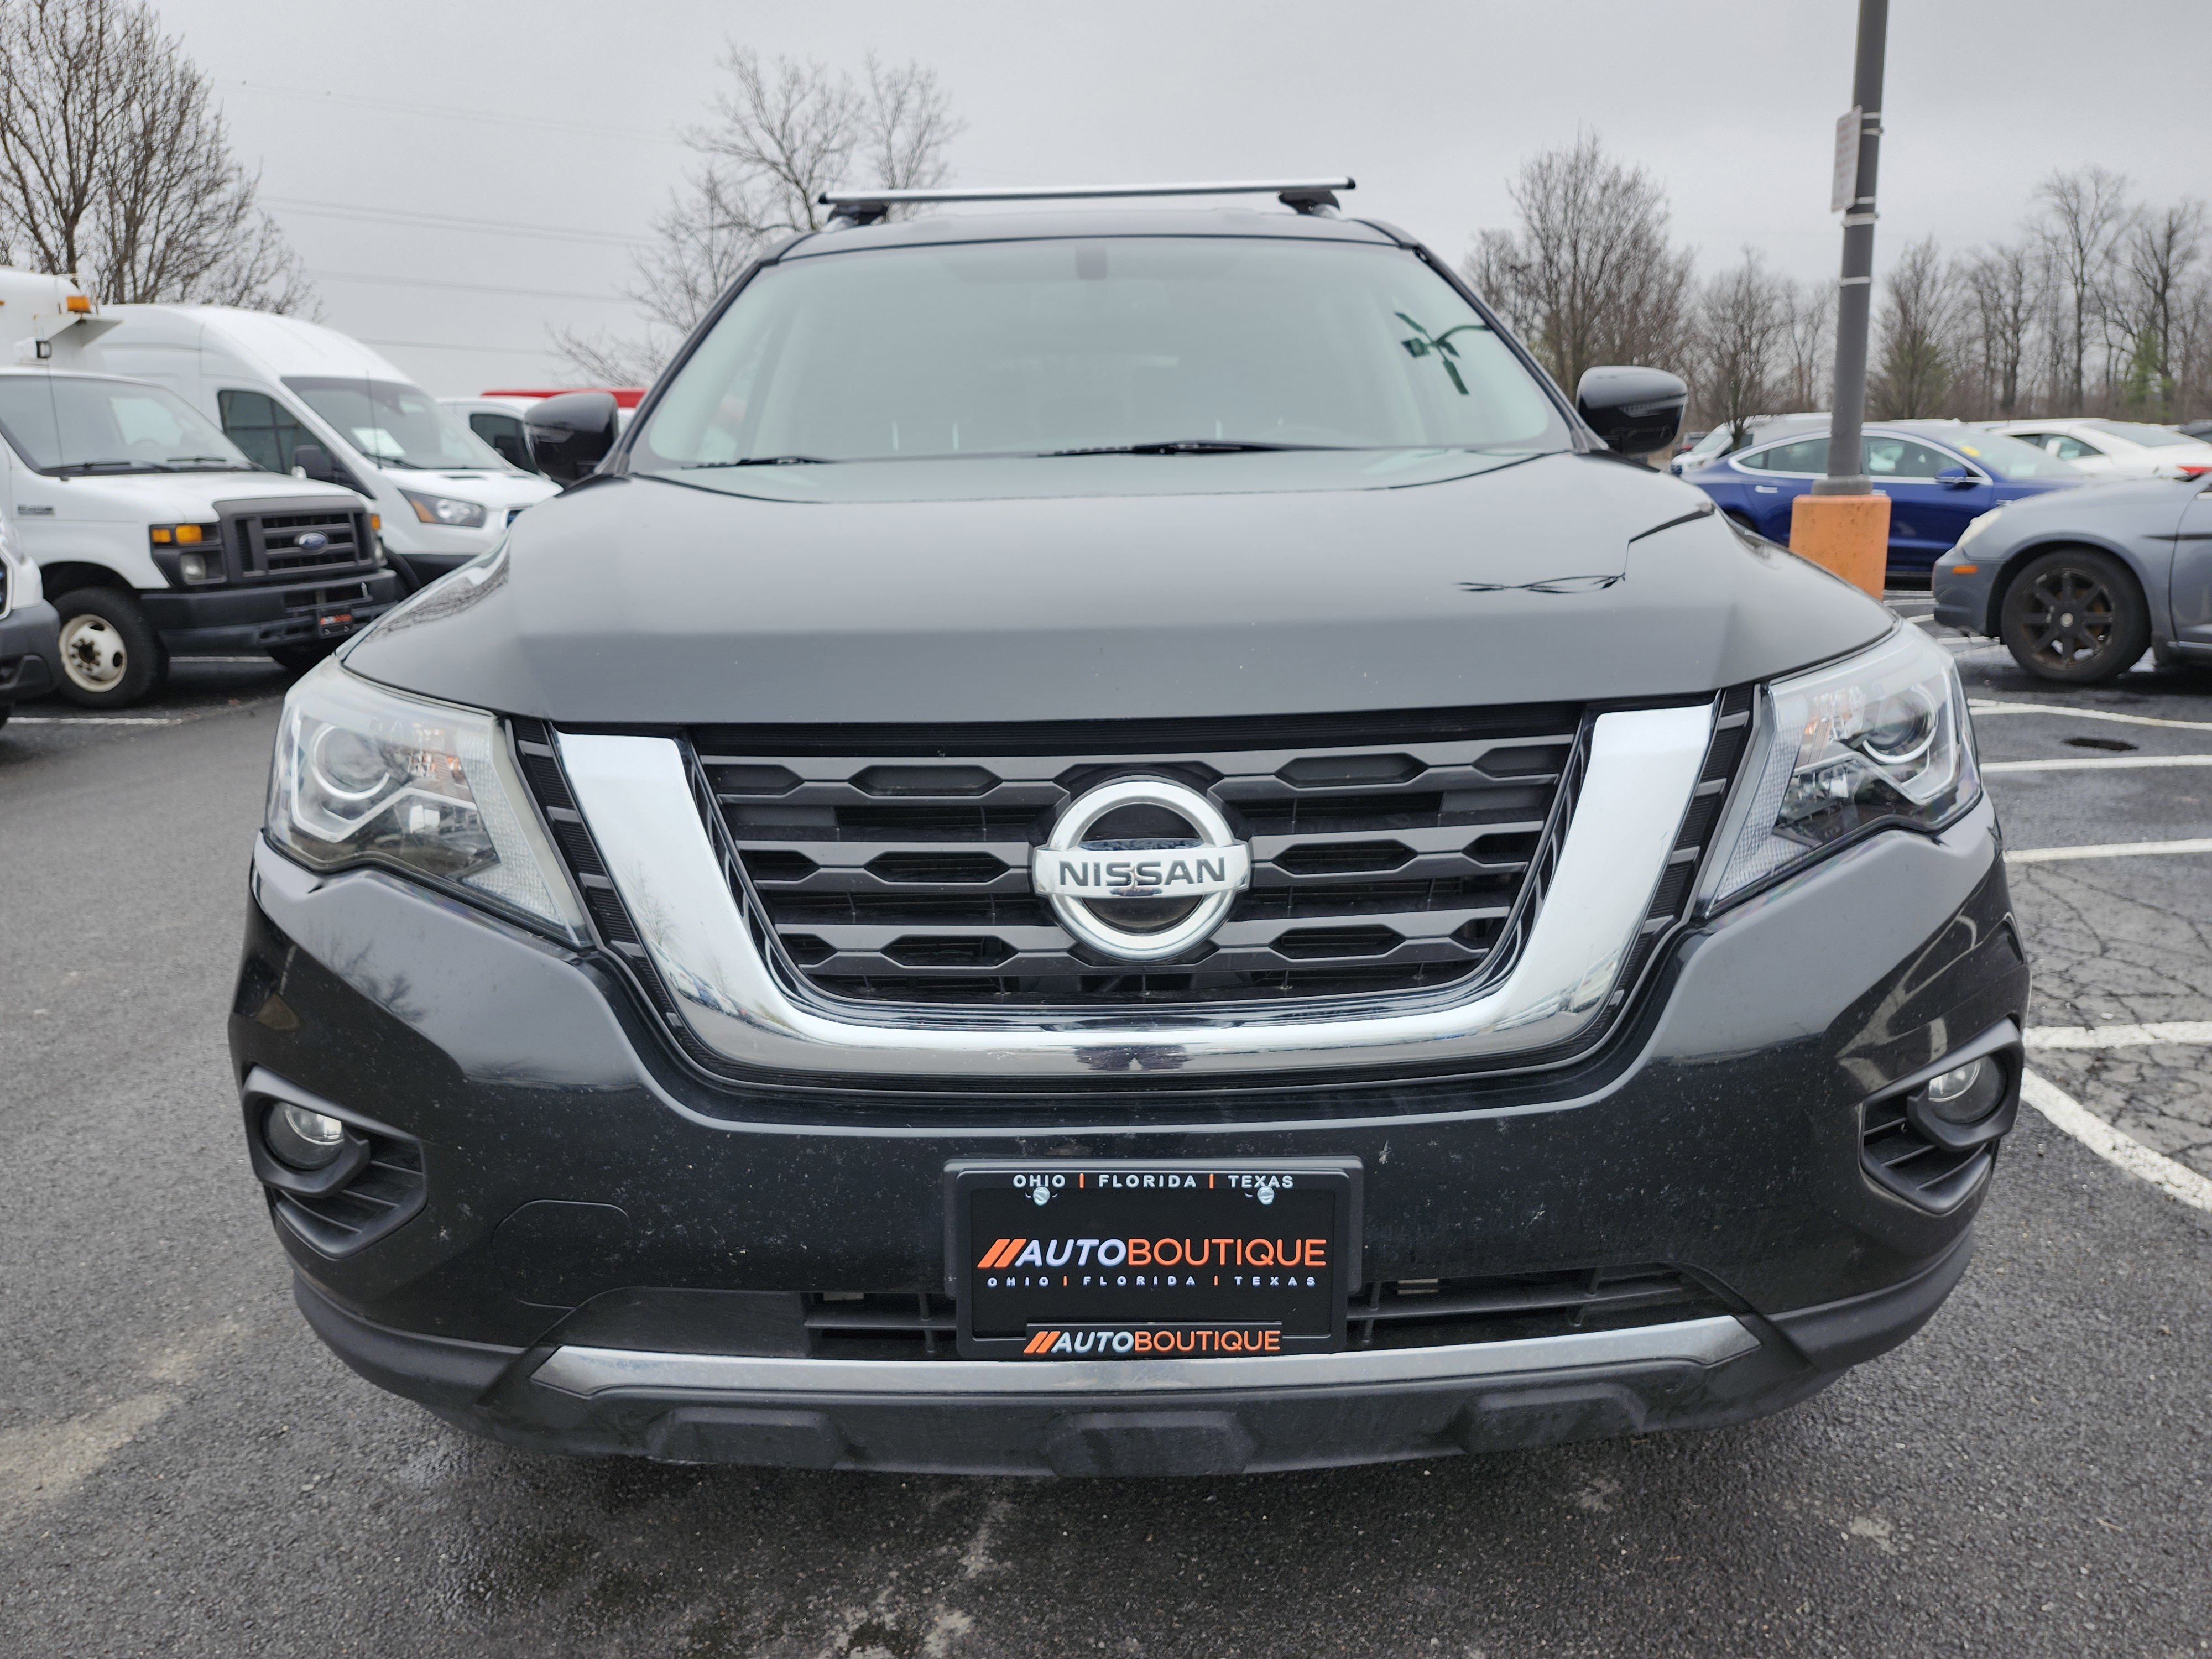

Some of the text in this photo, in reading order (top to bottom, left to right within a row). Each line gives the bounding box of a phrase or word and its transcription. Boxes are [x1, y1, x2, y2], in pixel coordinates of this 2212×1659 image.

[1058, 857, 1225, 887] NISSAN
[1013, 1174, 1293, 1188] OHIO FLORIDA TEXAS
[1014, 1238, 1327, 1266] AUTOBOUTIQUE
[987, 1275, 1316, 1288] OHIO FLORIDA TEXAS
[1051, 1330, 1281, 1353] AUTOBOUTIQUE
